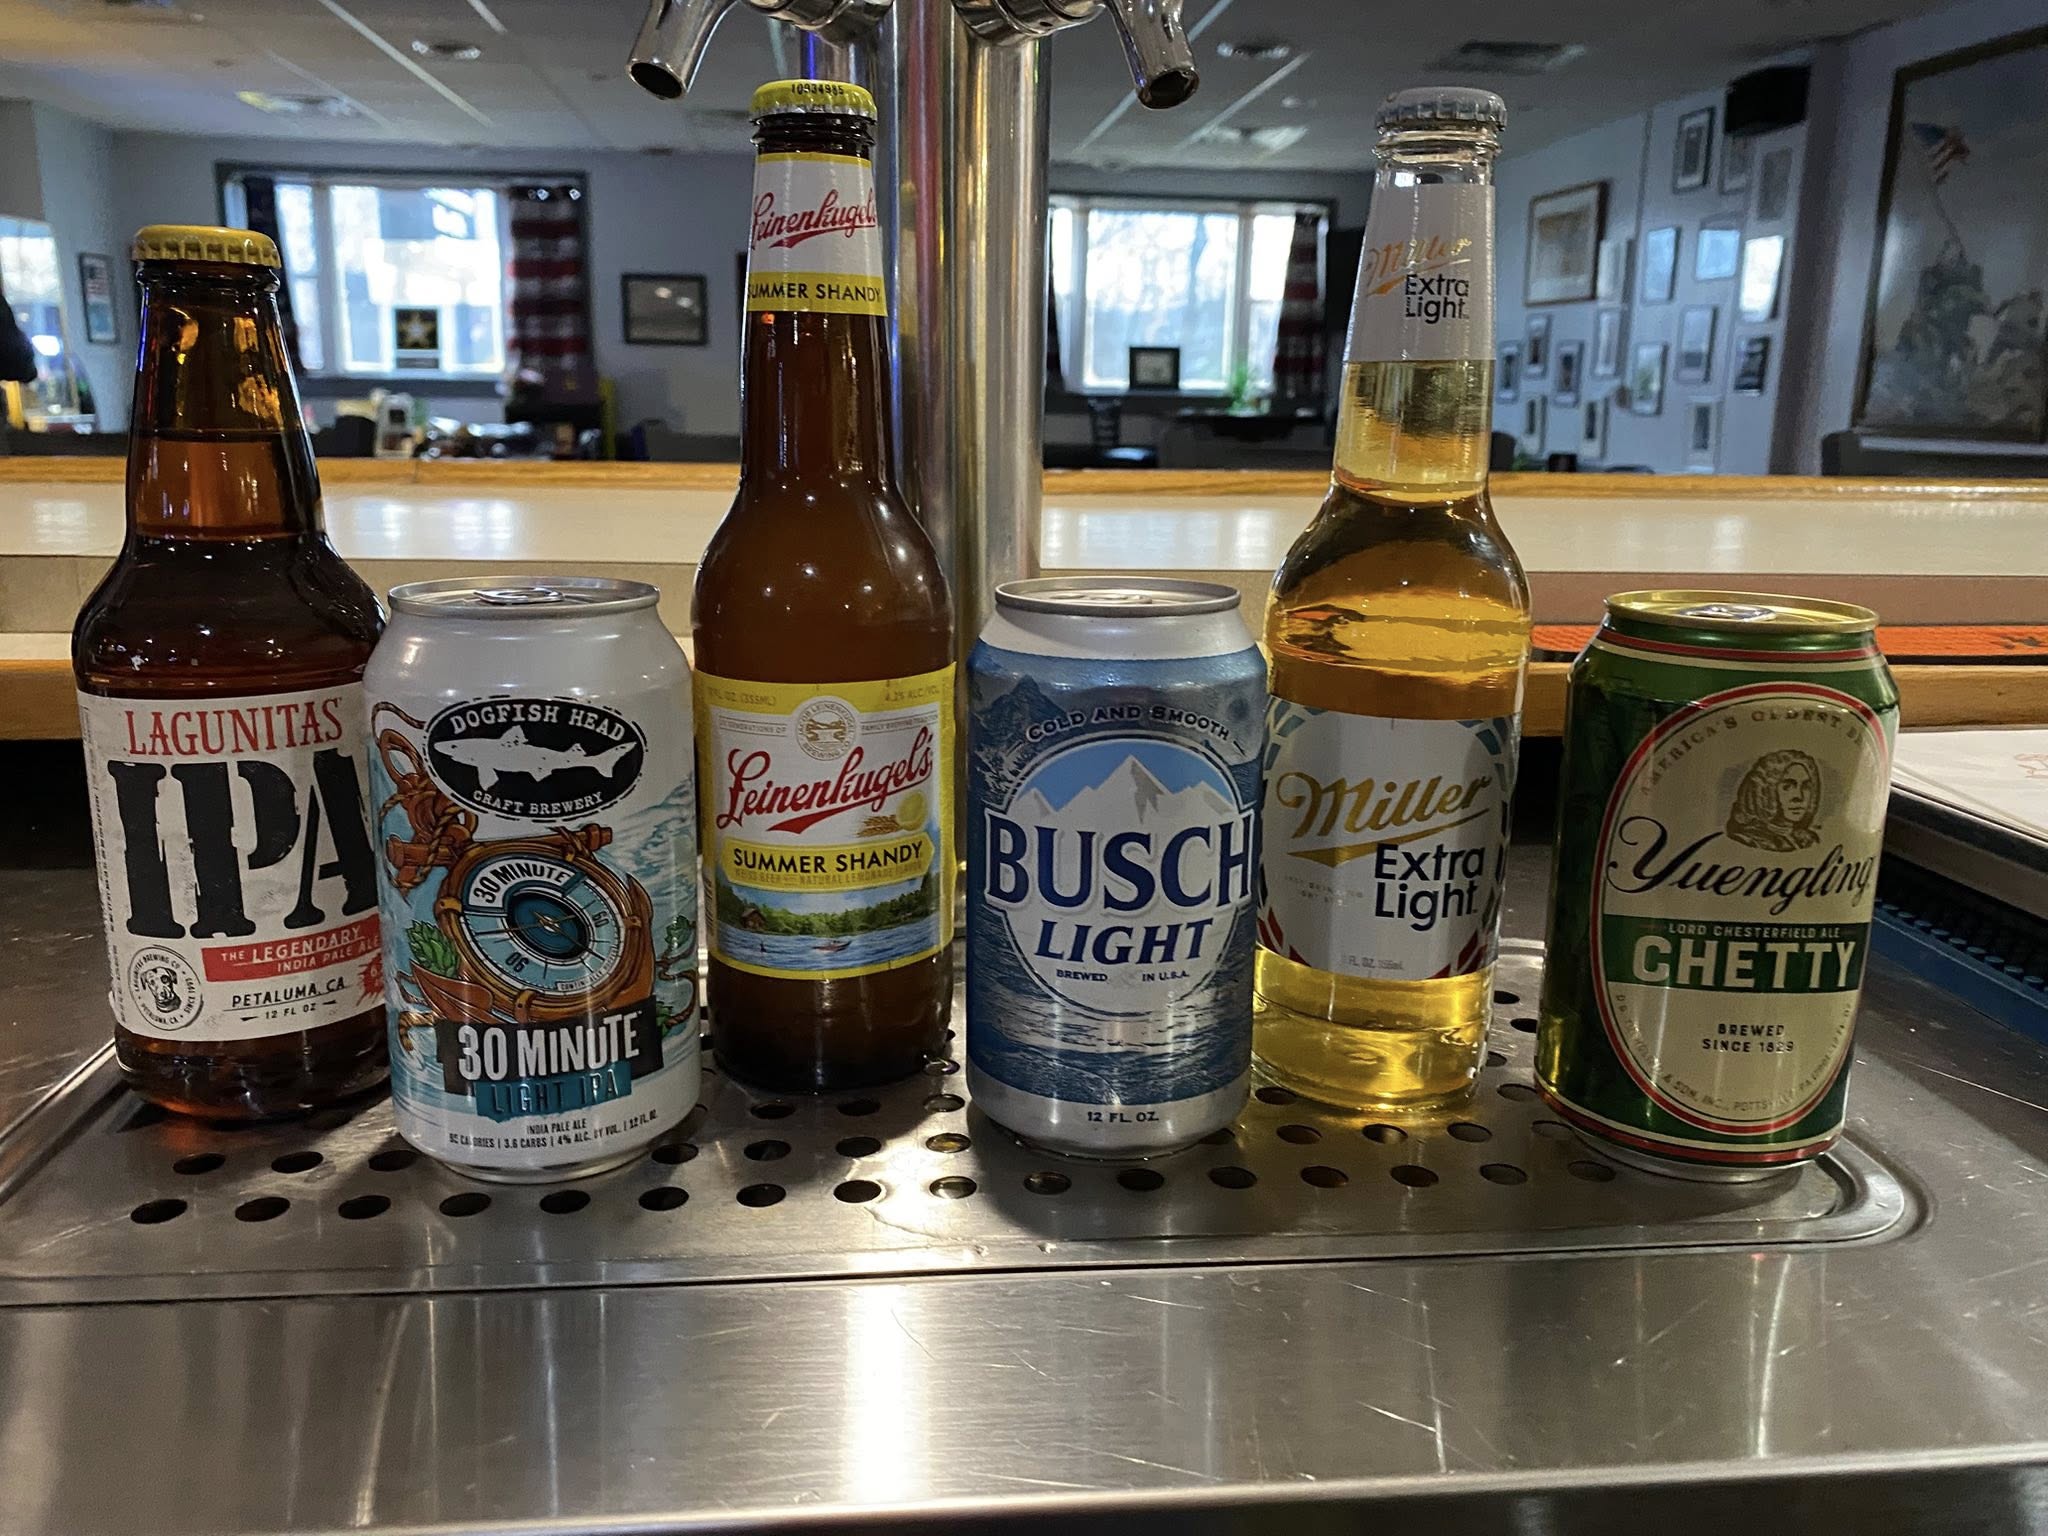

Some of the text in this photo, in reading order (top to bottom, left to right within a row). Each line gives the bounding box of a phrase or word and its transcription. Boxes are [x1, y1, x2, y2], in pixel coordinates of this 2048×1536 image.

[816, 284, 881, 301] SHANDY
[1405, 273, 1469, 297] Extra
[1405, 296, 1467, 324] Light
[124, 698, 342, 757] LAGUNITAS
[450, 703, 625, 742] DOGFISH HEAD
[1027, 705, 1230, 742] COLD AND SMOOTH
[1752, 708, 1842, 728] OLDEST
[716, 726, 933, 829] Leinenkugel's
[473, 789, 603, 815] CRAFT BREWERY
[1276, 772, 1492, 839] Miller
[107, 748, 379, 939] IPA
[734, 841, 922, 873] SUMMER SHANDY
[986, 812, 1252, 912] BUSCH
[1375, 843, 1485, 881] Extra
[473, 863, 571, 904] 30 MINUTE
[1605, 816, 1876, 916] Yuengling
[1375, 880, 1477, 932] Light
[221, 925, 361, 964] THE LEGENDARY
[1034, 917, 1213, 965] LIGHT
[1669, 924, 1840, 939] LORD CHESTERFIELD ALE
[277, 935, 379, 973] INDIA PALE ALE
[1632, 935, 1855, 989] CHETTY
[326, 976, 346, 993] CA
[1055, 969, 1108, 983] BREWED
[1142, 971, 1156, 982] IN
[265, 1004, 317, 1020] 12 FL OZ
[1717, 1023, 1785, 1037] BREWED
[457, 1010, 640, 1081] 30 MINUTE
[1702, 1038, 1751, 1052] SINCE
[491, 1068, 619, 1113] LIGHT IPA
[526, 1118, 587, 1135] INDIA PALE ALE
[1087, 1111, 1103, 1123] 12
[460, 1134, 495, 1148] CAORIES
[520, 1136, 548, 1149] CARBS
[557, 1134, 572, 1146] 4%
